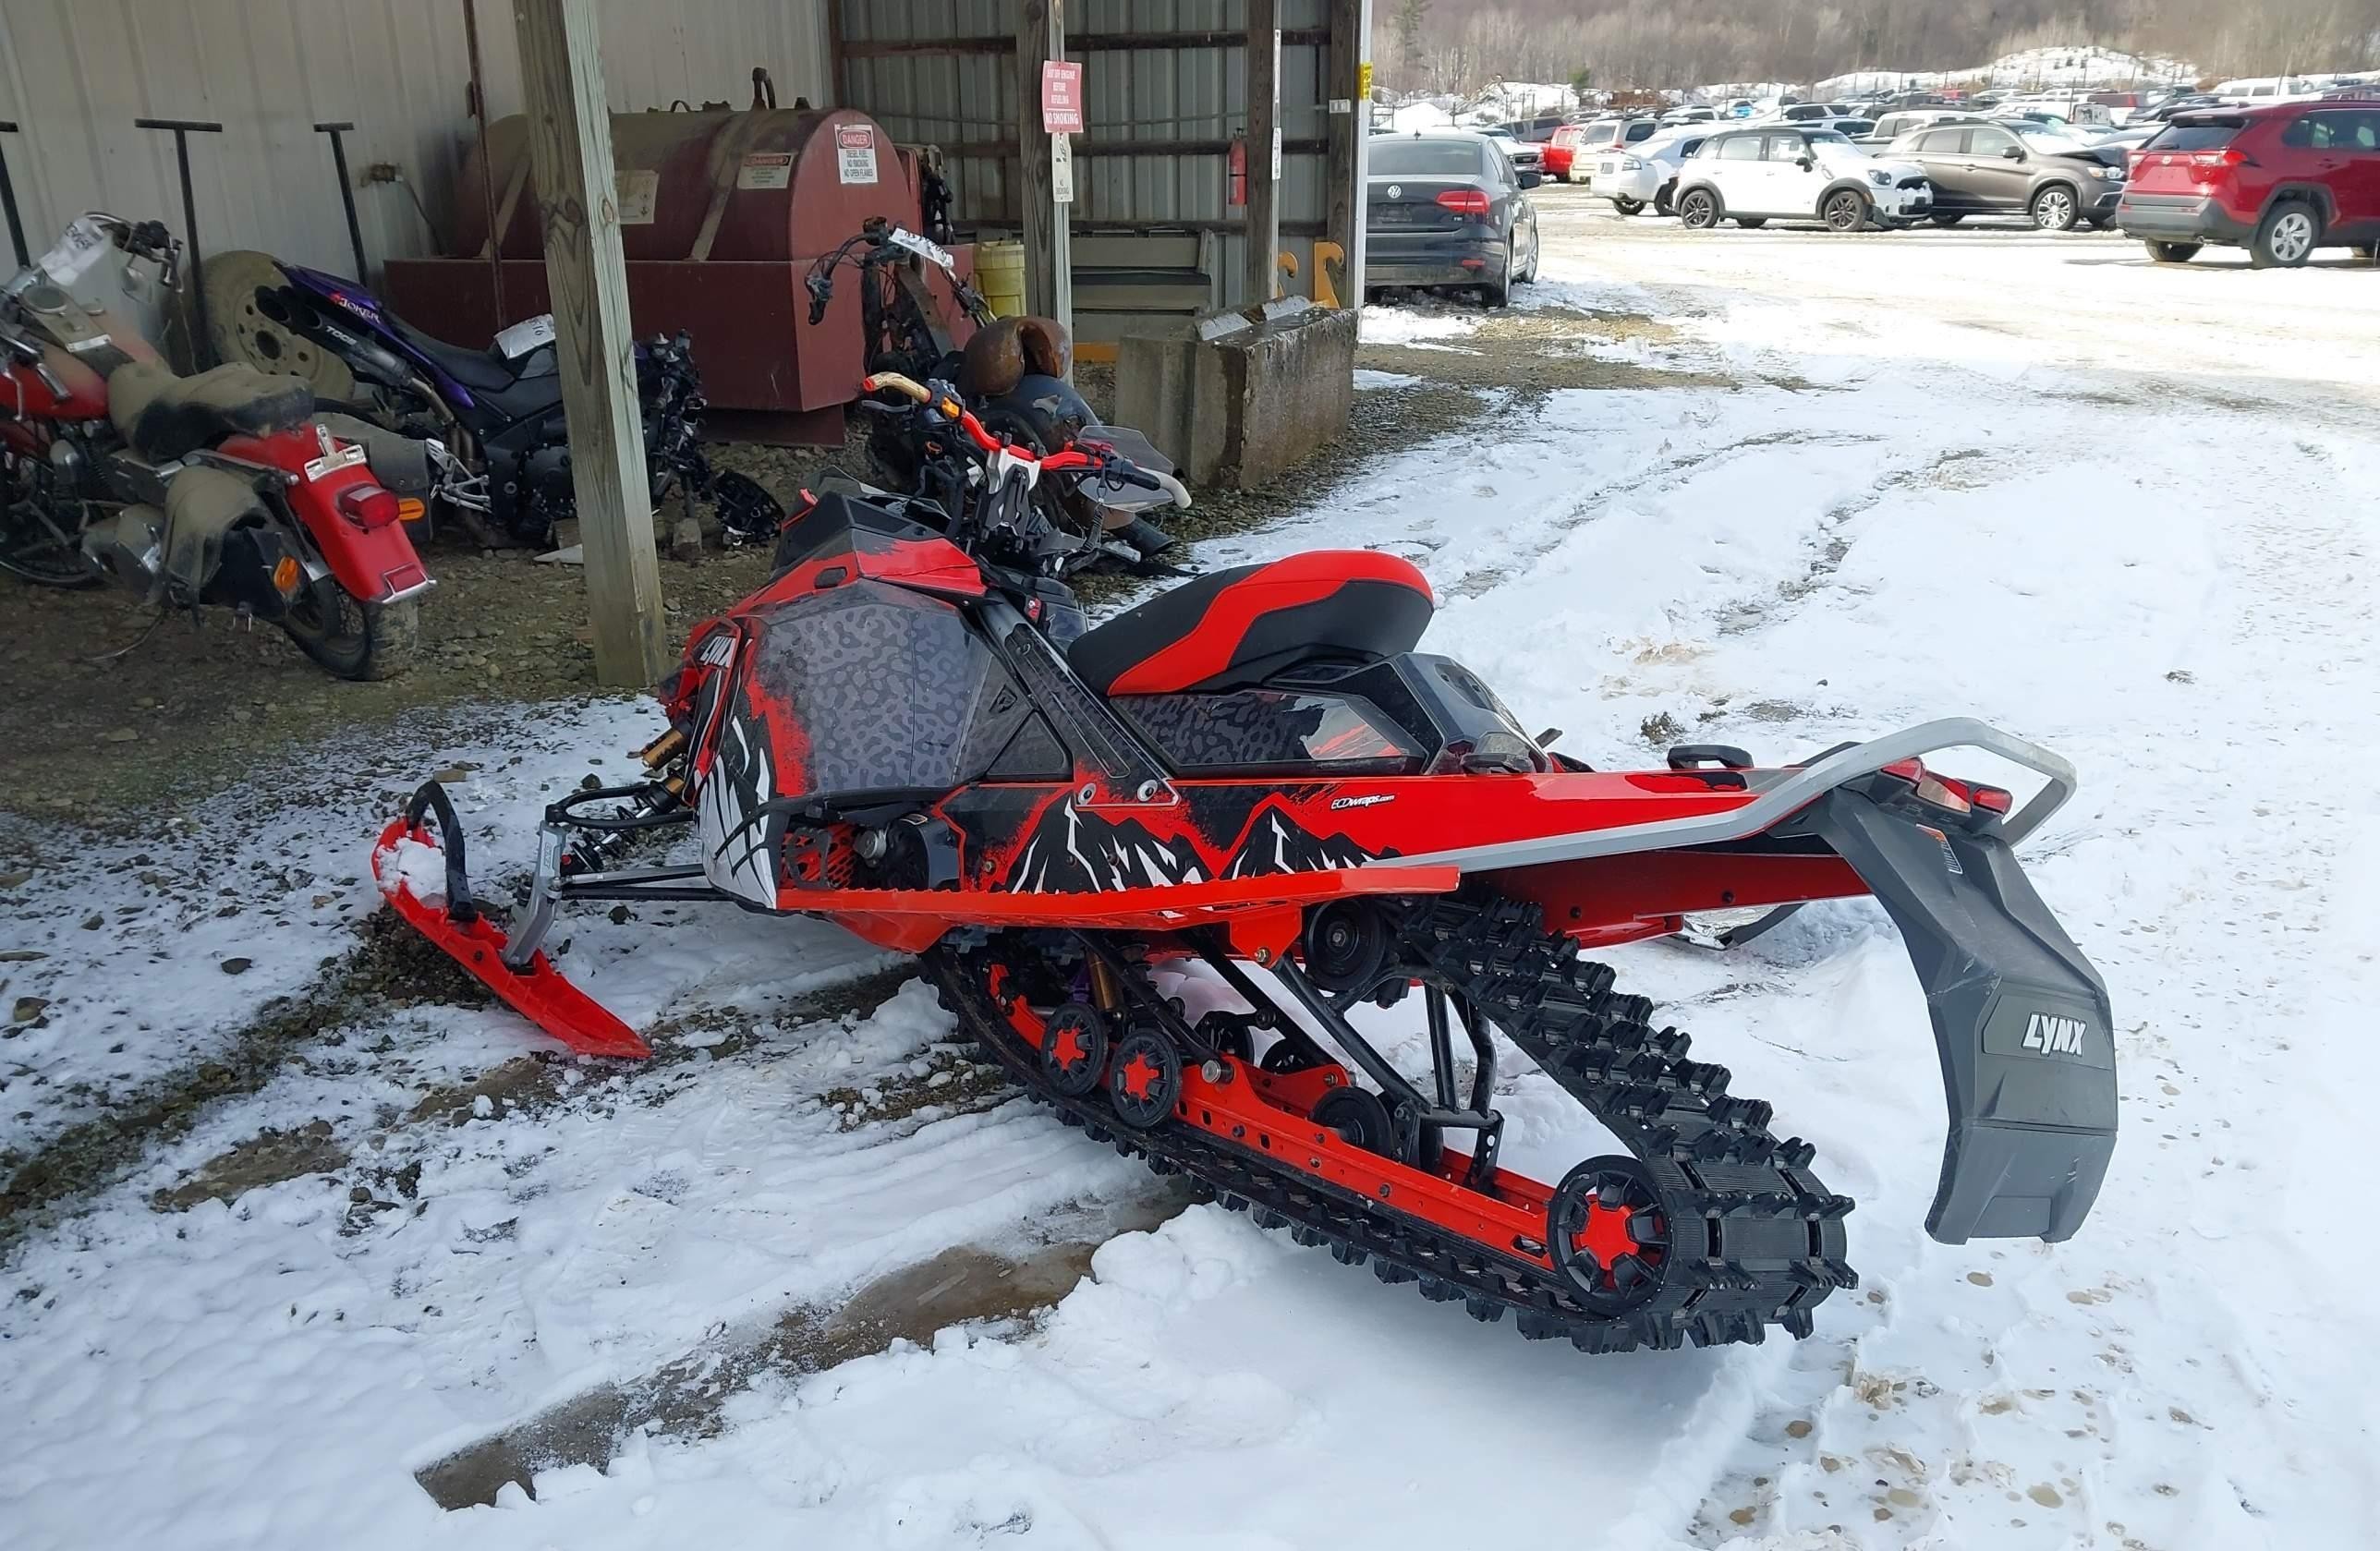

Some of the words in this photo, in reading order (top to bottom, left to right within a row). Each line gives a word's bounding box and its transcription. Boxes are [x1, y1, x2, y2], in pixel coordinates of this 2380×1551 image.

[1045, 112, 1052, 124] NO
[1053, 112, 1079, 126] SMOKING
[842, 134, 868, 145] DANGER
[338, 297, 381, 324] JOKER
[699, 636, 736, 669] LYNX
[2022, 1012, 2087, 1056] LYNX
